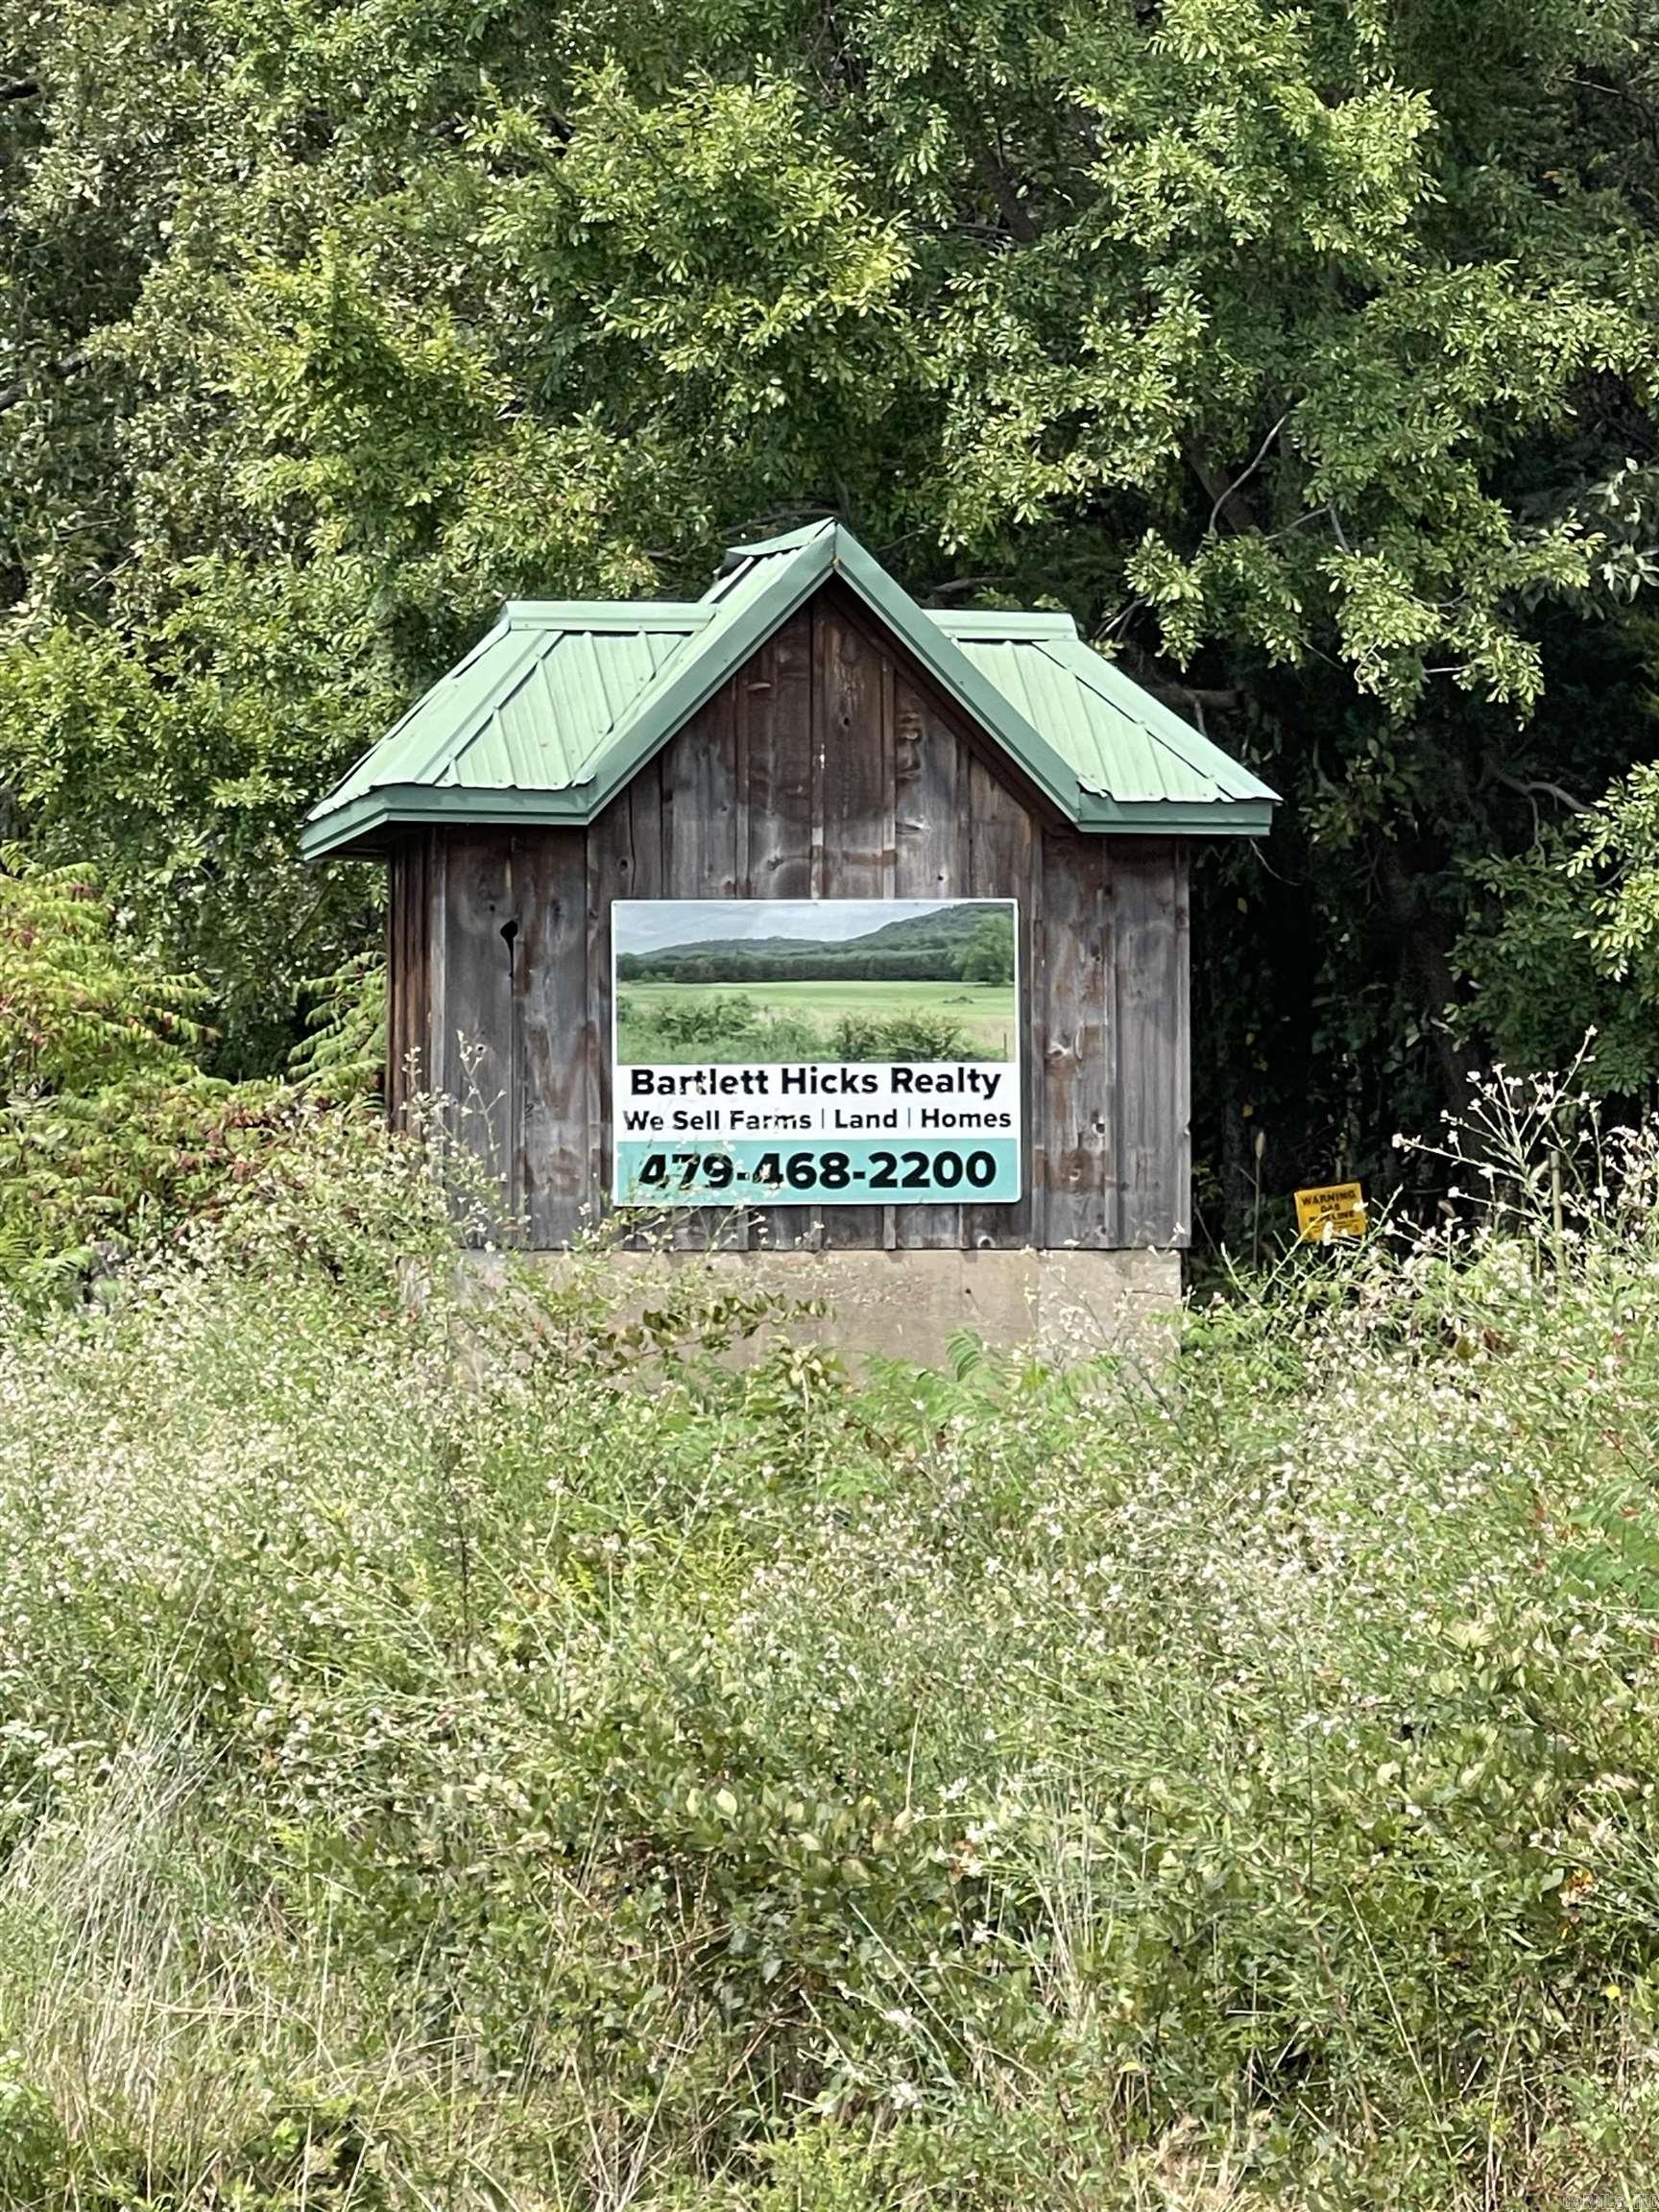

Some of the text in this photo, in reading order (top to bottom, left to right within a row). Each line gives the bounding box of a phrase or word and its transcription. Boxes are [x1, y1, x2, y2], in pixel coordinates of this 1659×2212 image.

[631, 1066, 1001, 1100] Bartlett Hicks Realty
[623, 1108, 1011, 1131] We Sell Farms Land Homes
[638, 1150, 997, 1190] 479-468-2200
[1301, 1190, 1357, 1207] WARNING
